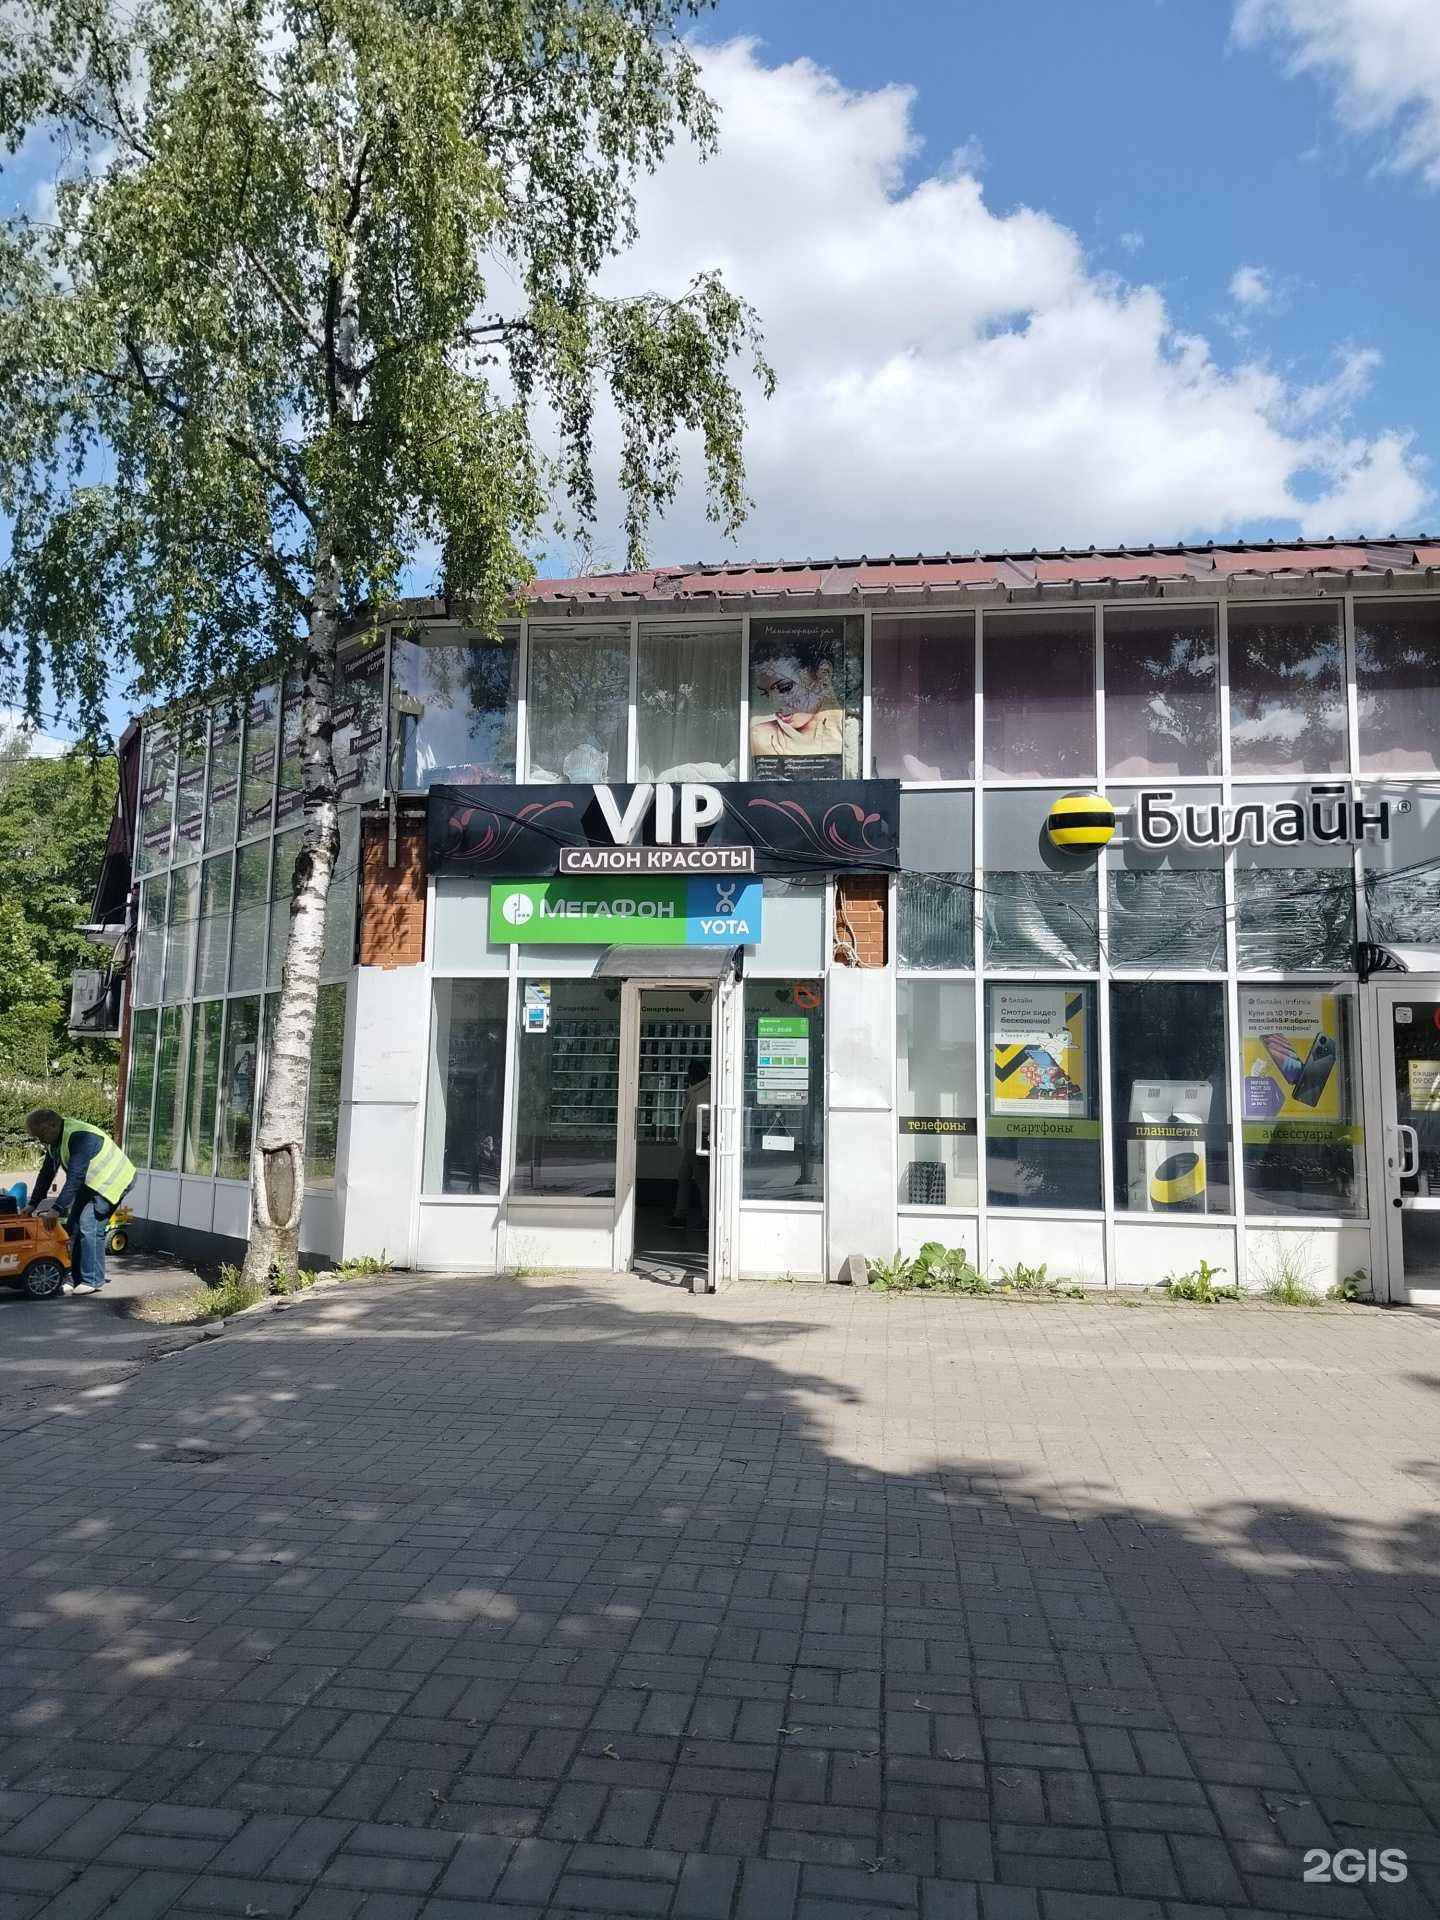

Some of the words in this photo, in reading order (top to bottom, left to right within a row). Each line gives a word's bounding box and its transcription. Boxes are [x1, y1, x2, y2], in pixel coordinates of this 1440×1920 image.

[592, 783, 724, 846] VIP
[1138, 785, 1391, 846] Билайн
[566, 851, 641, 869] САЛОН
[647, 850, 748, 868] КРАСОТЫ
[700, 919, 750, 936] YOTA
[1001, 1008, 1031, 1018] Смотри
[907, 1119, 968, 1134] телефоны
[1006, 1122, 1074, 1136] смартфоны
[1135, 1126, 1200, 1138] планшеты
[1262, 1128, 1333, 1142] аксессуары
